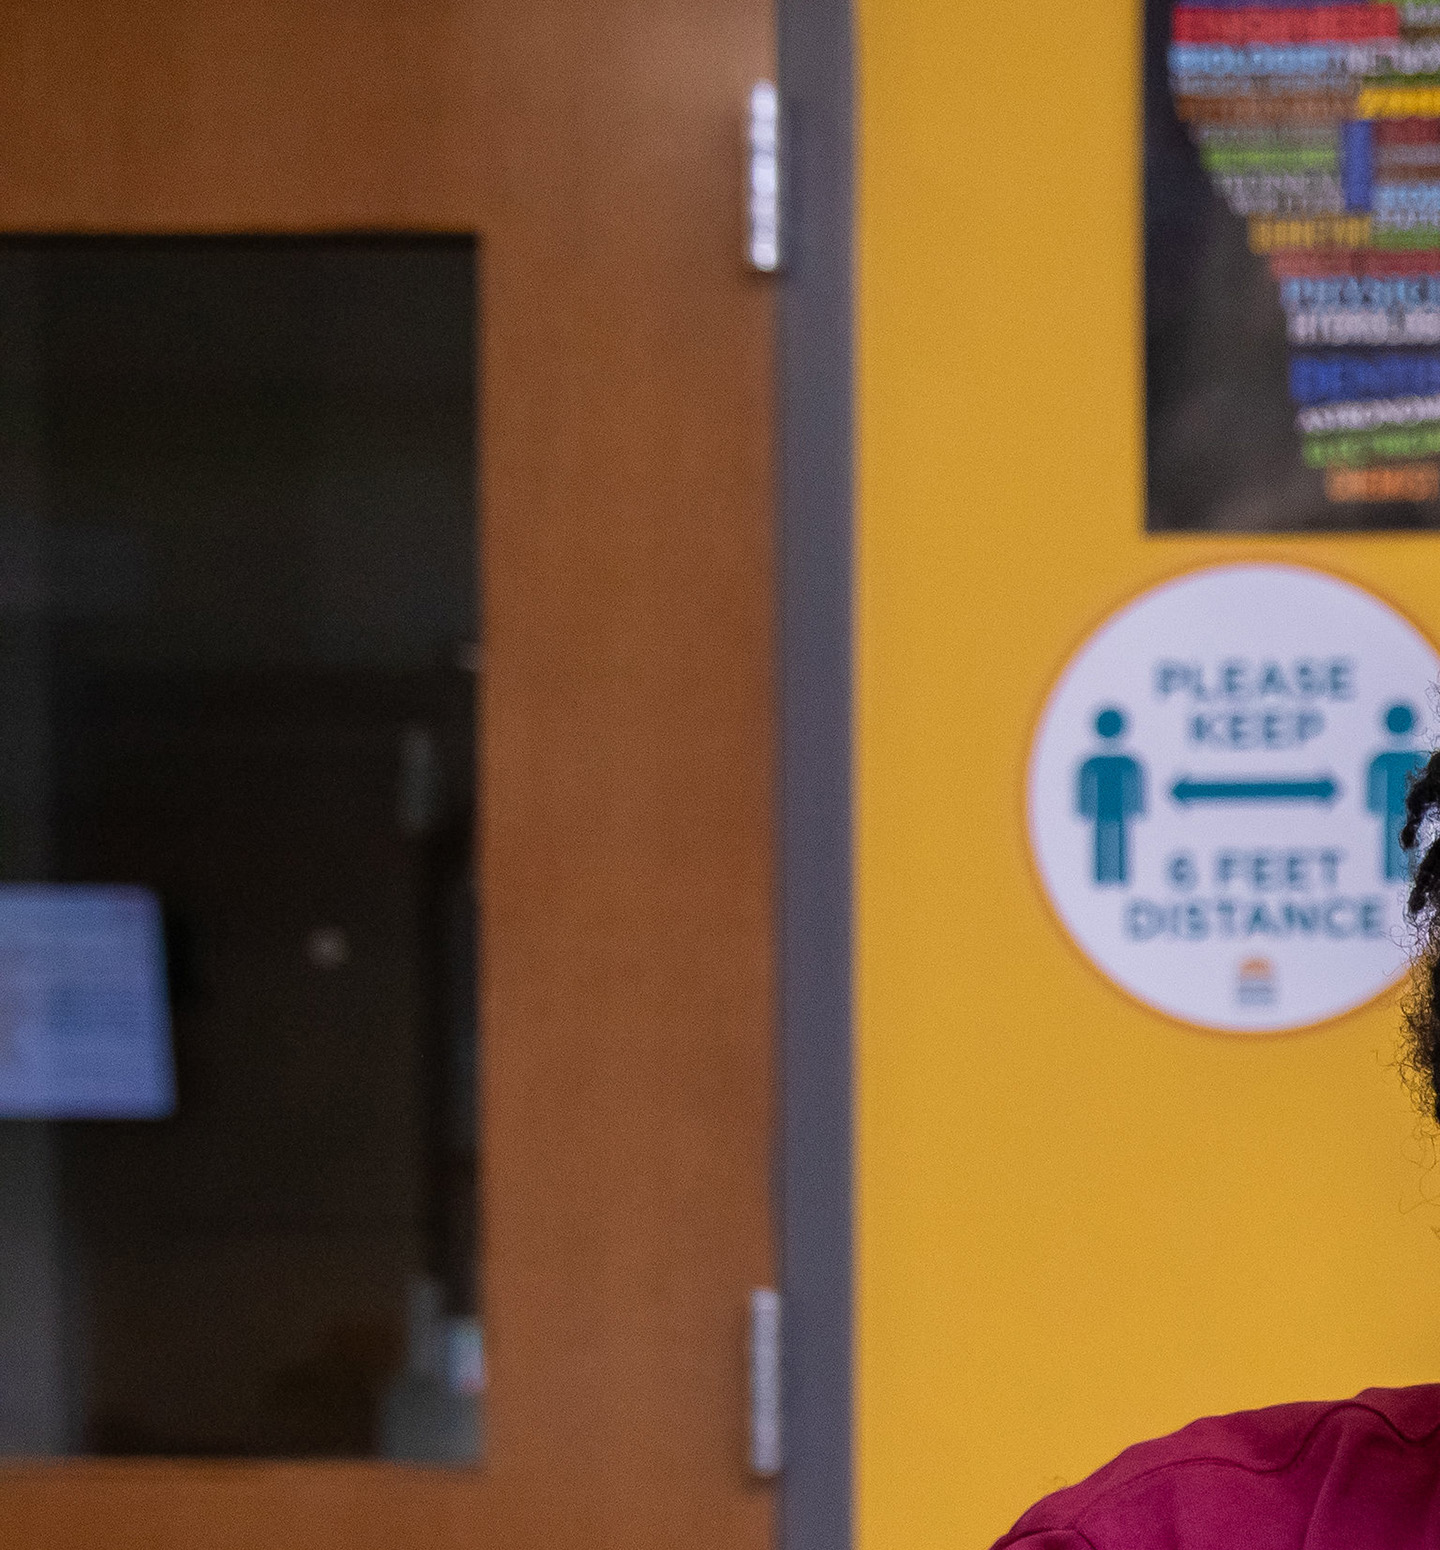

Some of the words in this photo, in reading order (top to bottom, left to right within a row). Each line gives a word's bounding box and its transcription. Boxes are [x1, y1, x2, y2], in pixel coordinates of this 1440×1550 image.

[1156, 659, 1355, 700] PLEASE
[1190, 709, 1328, 747] KEEP
[1168, 852, 1195, 889] 6
[1217, 850, 1344, 889] FEET
[1126, 898, 1384, 940] DISTANCE
